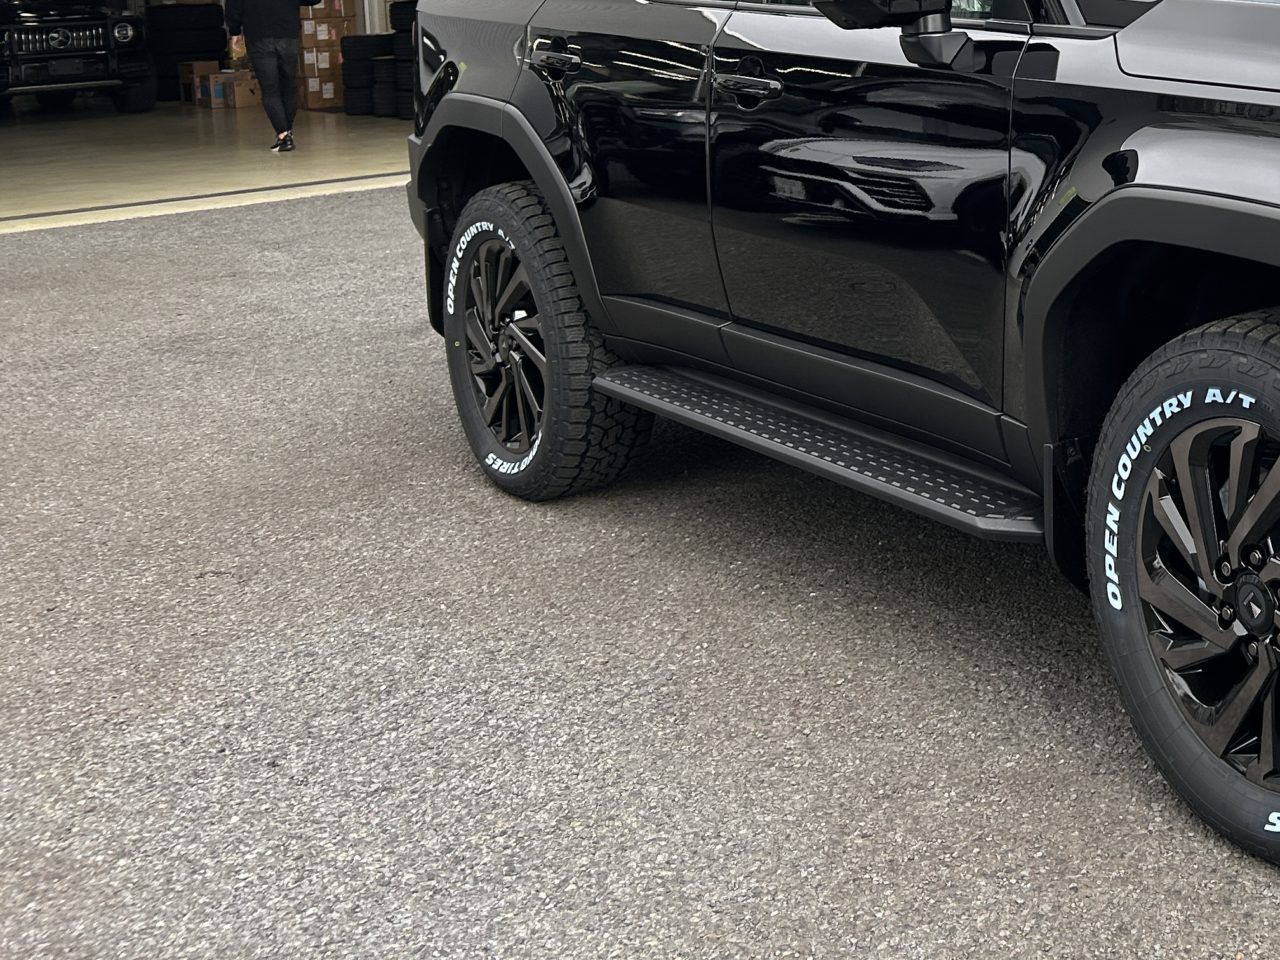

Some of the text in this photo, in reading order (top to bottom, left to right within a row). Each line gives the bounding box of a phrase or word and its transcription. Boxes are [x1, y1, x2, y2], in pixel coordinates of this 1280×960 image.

[447, 257, 460, 315] OPEN
[456, 221, 494, 259] COUNTRY
[485, 452, 520, 474] TIRES
[1104, 388, 1256, 611] OPEN COUNTRY A/T
